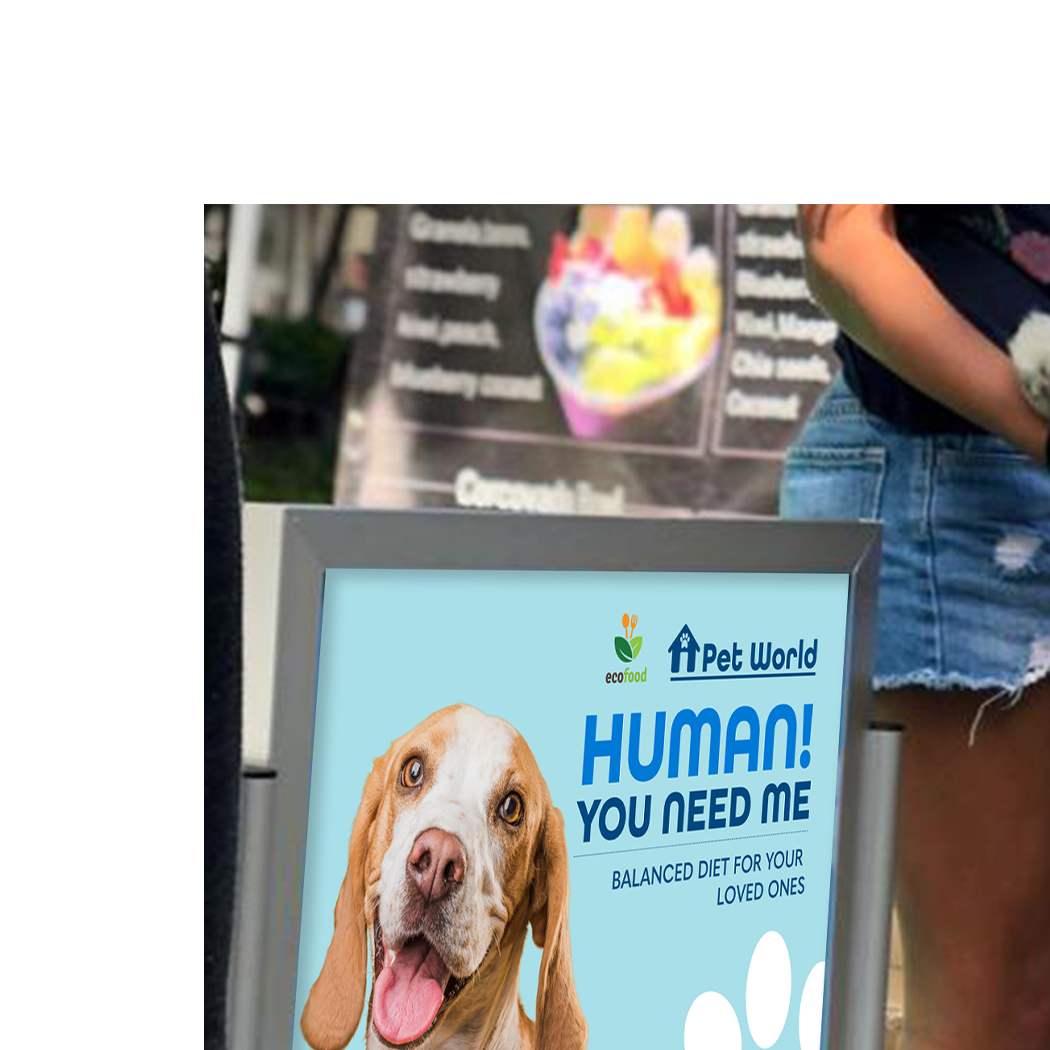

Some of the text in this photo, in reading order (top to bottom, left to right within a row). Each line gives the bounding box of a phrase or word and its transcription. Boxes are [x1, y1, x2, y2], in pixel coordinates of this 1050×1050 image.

[701, 638, 819, 673] Pet World
[605, 667, 648, 685] ecofood
[581, 703, 814, 786] HUMAN!
[576, 780, 812, 843] YOU NEED ME
[611, 848, 804, 891] BALANCED DIET FOR YOUR
[716, 876, 806, 906] LOVED ONES
